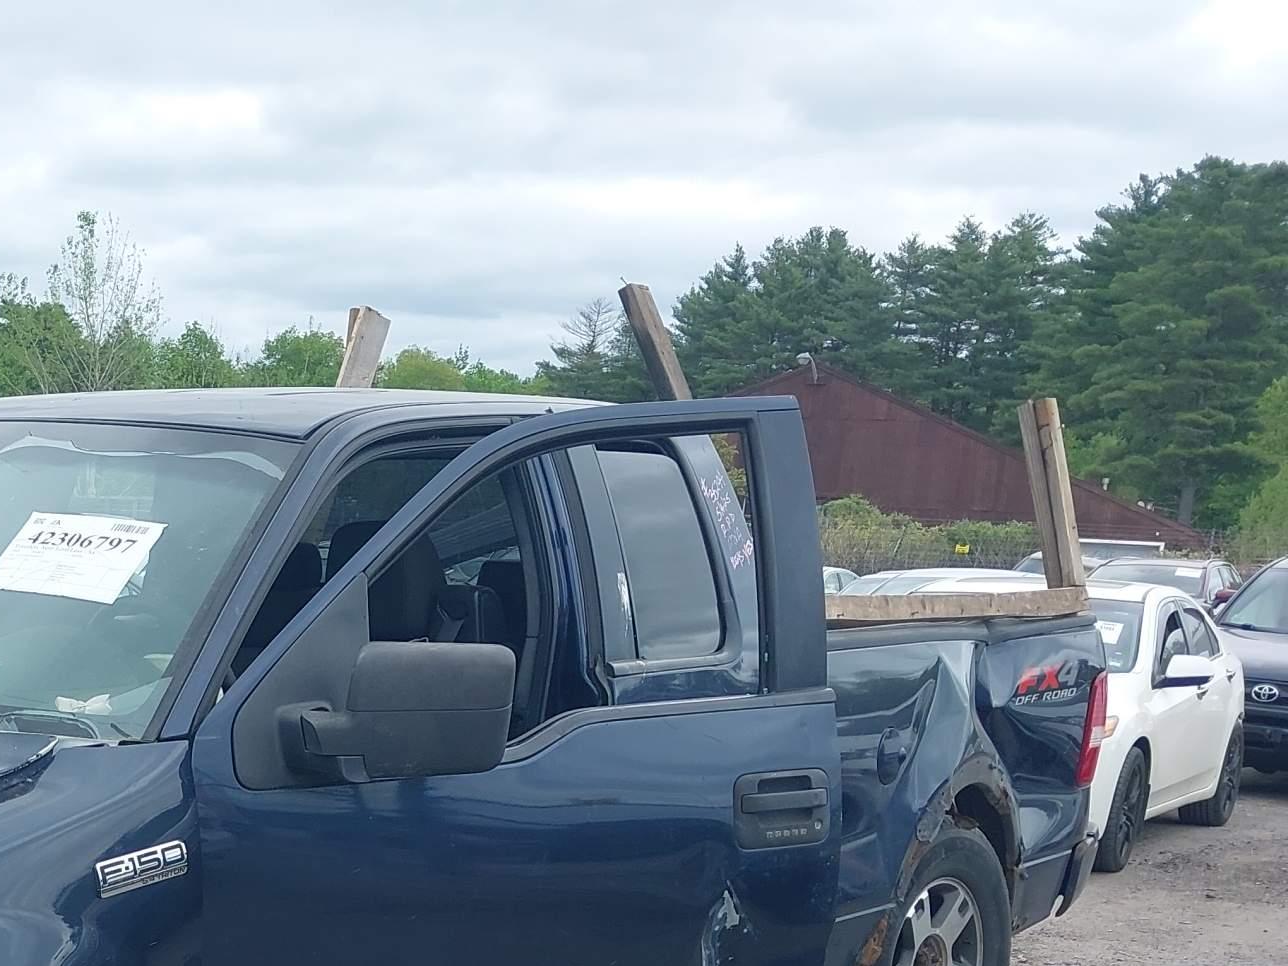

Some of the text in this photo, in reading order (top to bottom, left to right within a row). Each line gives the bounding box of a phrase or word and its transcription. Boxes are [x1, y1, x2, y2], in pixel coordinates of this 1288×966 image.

[27, 531, 139, 554] 42306797
[1018, 659, 1080, 695] FX4
[1015, 687, 1078, 706] OFF ROAD
